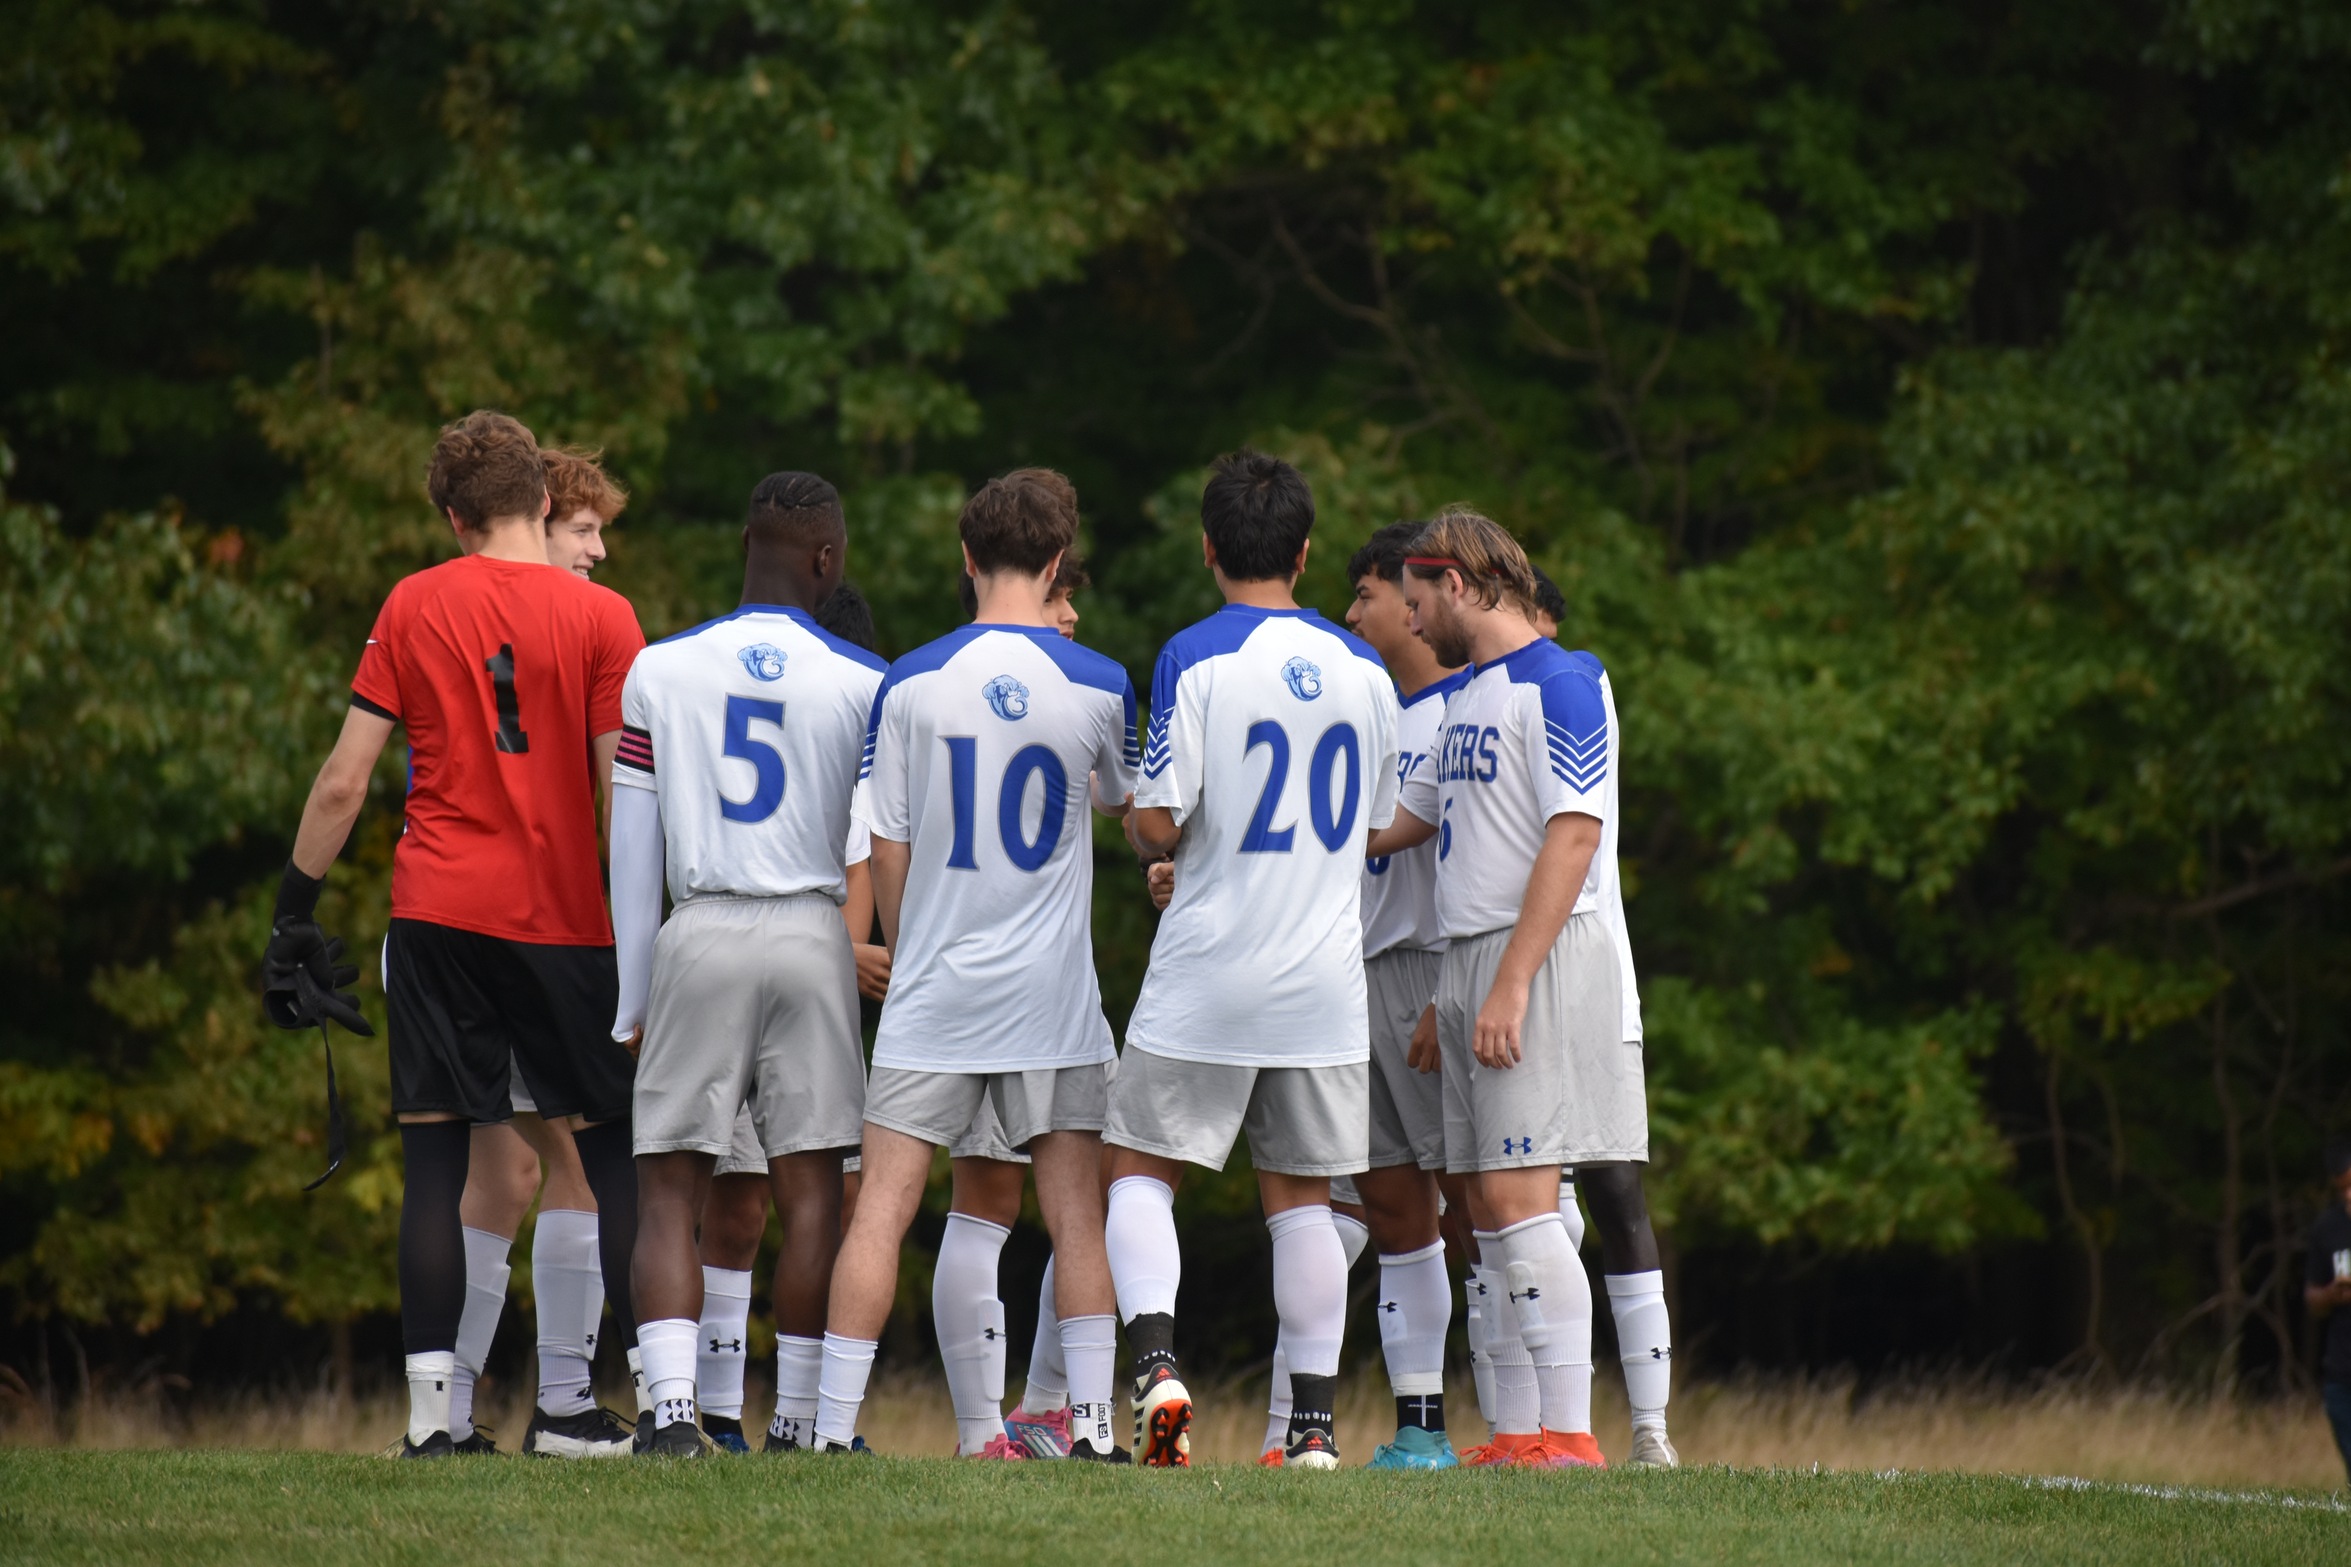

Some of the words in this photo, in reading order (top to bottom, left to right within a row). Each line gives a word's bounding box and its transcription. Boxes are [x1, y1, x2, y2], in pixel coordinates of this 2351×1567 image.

[485, 643, 530, 754] 1
[717, 693, 787, 825] 5
[938, 735, 1068, 873] 10
[1237, 717, 1361, 854] 20
